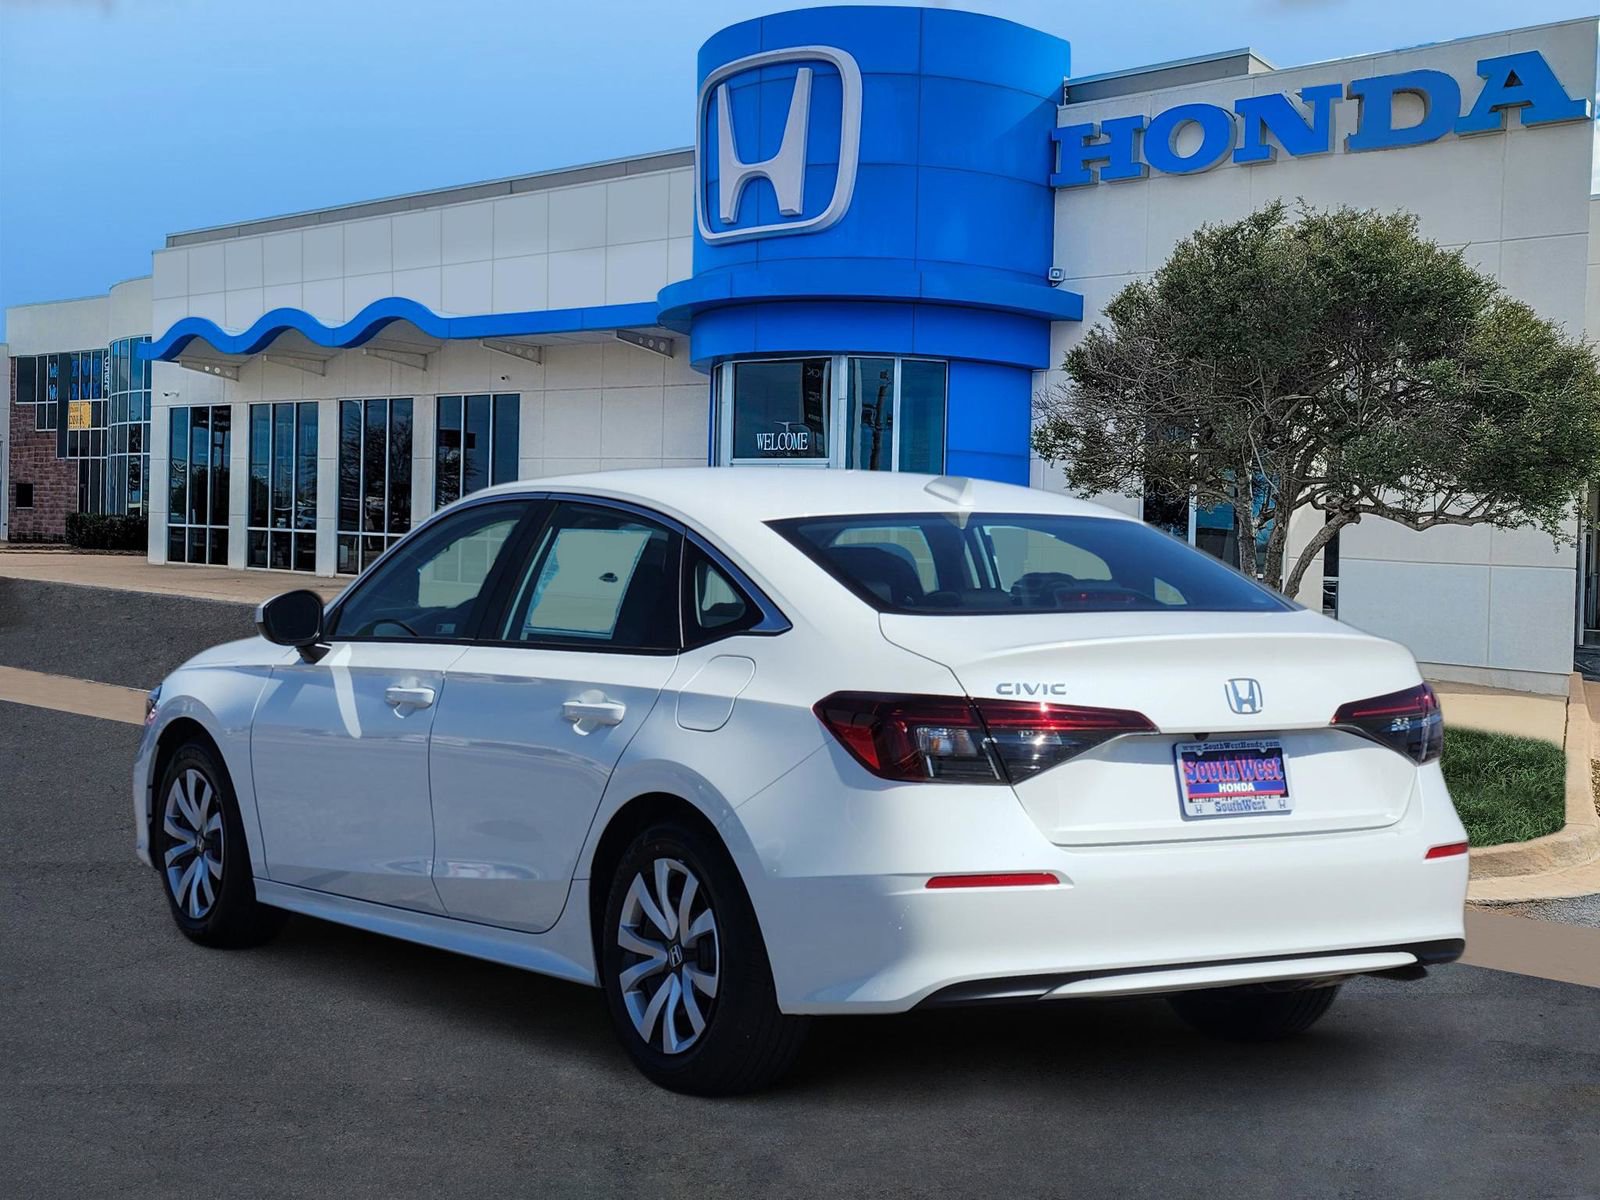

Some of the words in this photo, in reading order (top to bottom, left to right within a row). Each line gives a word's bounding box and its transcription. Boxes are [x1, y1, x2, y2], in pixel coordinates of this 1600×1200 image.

[1051, 49, 1592, 187] HONDA
[757, 432, 808, 450] WELCOME
[996, 683, 1067, 695] CIVIC
[1219, 782, 1255, 793] HONDA
[1215, 799, 1267, 812] SouthWest
